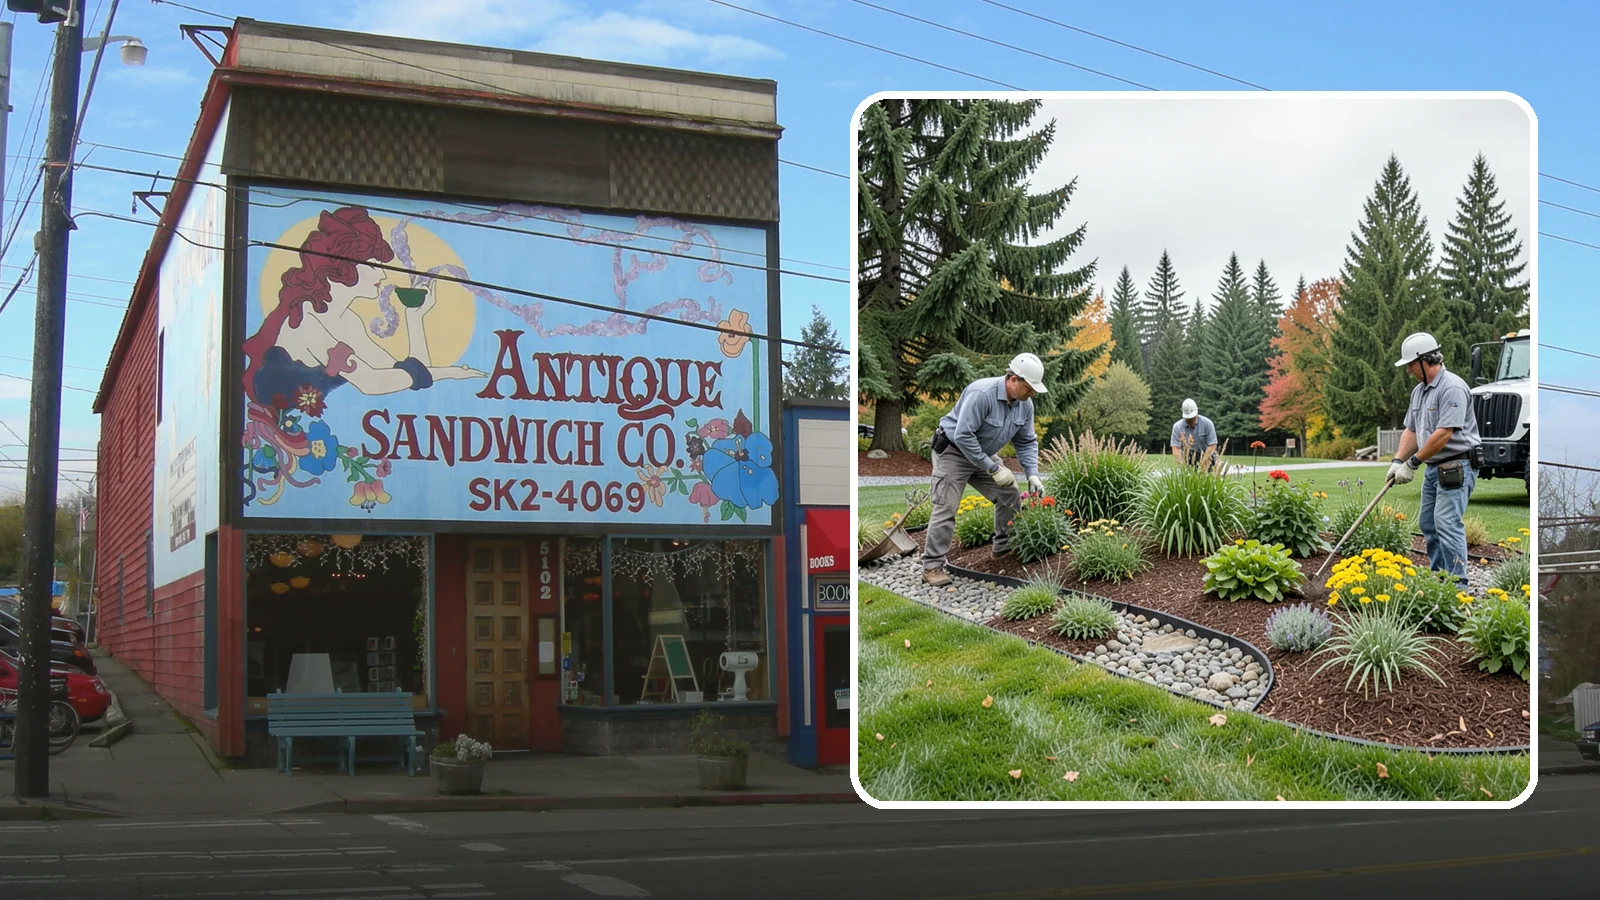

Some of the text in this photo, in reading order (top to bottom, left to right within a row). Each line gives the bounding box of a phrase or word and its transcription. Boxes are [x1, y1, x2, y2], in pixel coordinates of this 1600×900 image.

[475, 328, 724, 421] ANTIQUE
[361, 407, 685, 469] SANDWICH CO.
[468, 477, 647, 513] SK2-4069
[540, 541, 552, 600] 5102
[809, 555, 835, 569] BOOKS
